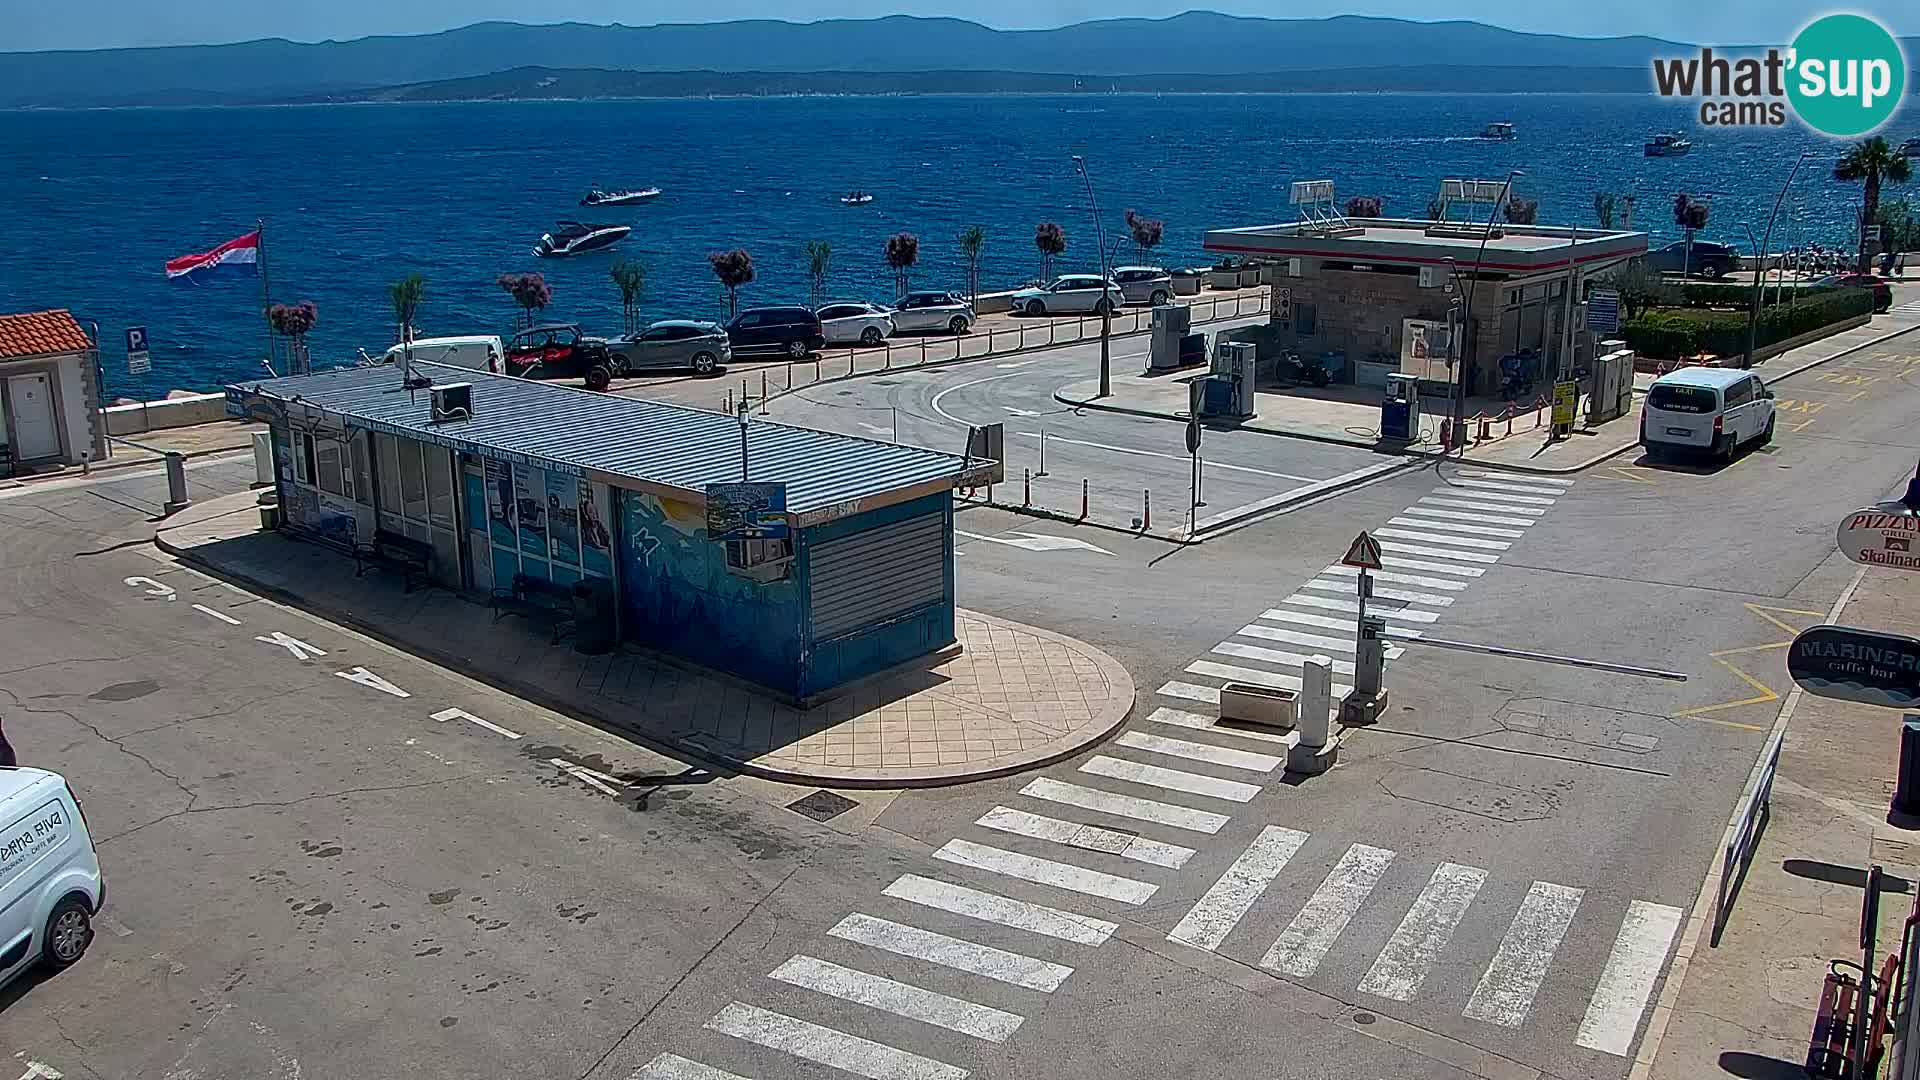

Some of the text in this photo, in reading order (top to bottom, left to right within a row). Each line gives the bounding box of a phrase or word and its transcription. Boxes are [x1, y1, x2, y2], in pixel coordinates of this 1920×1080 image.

[130, 330, 142, 349] P
[1815, 372, 1880, 387] TAXI
[1675, 387, 1693, 396] TAXI
[437, 435, 467, 450] POSTAJA
[478, 446, 583, 477] BUS STATION TICKET OFFICE
[1881, 529, 1917, 540] GRILL
[1828, 661, 1897, 679] caffe bar
[47, 833, 57, 845] BAR
